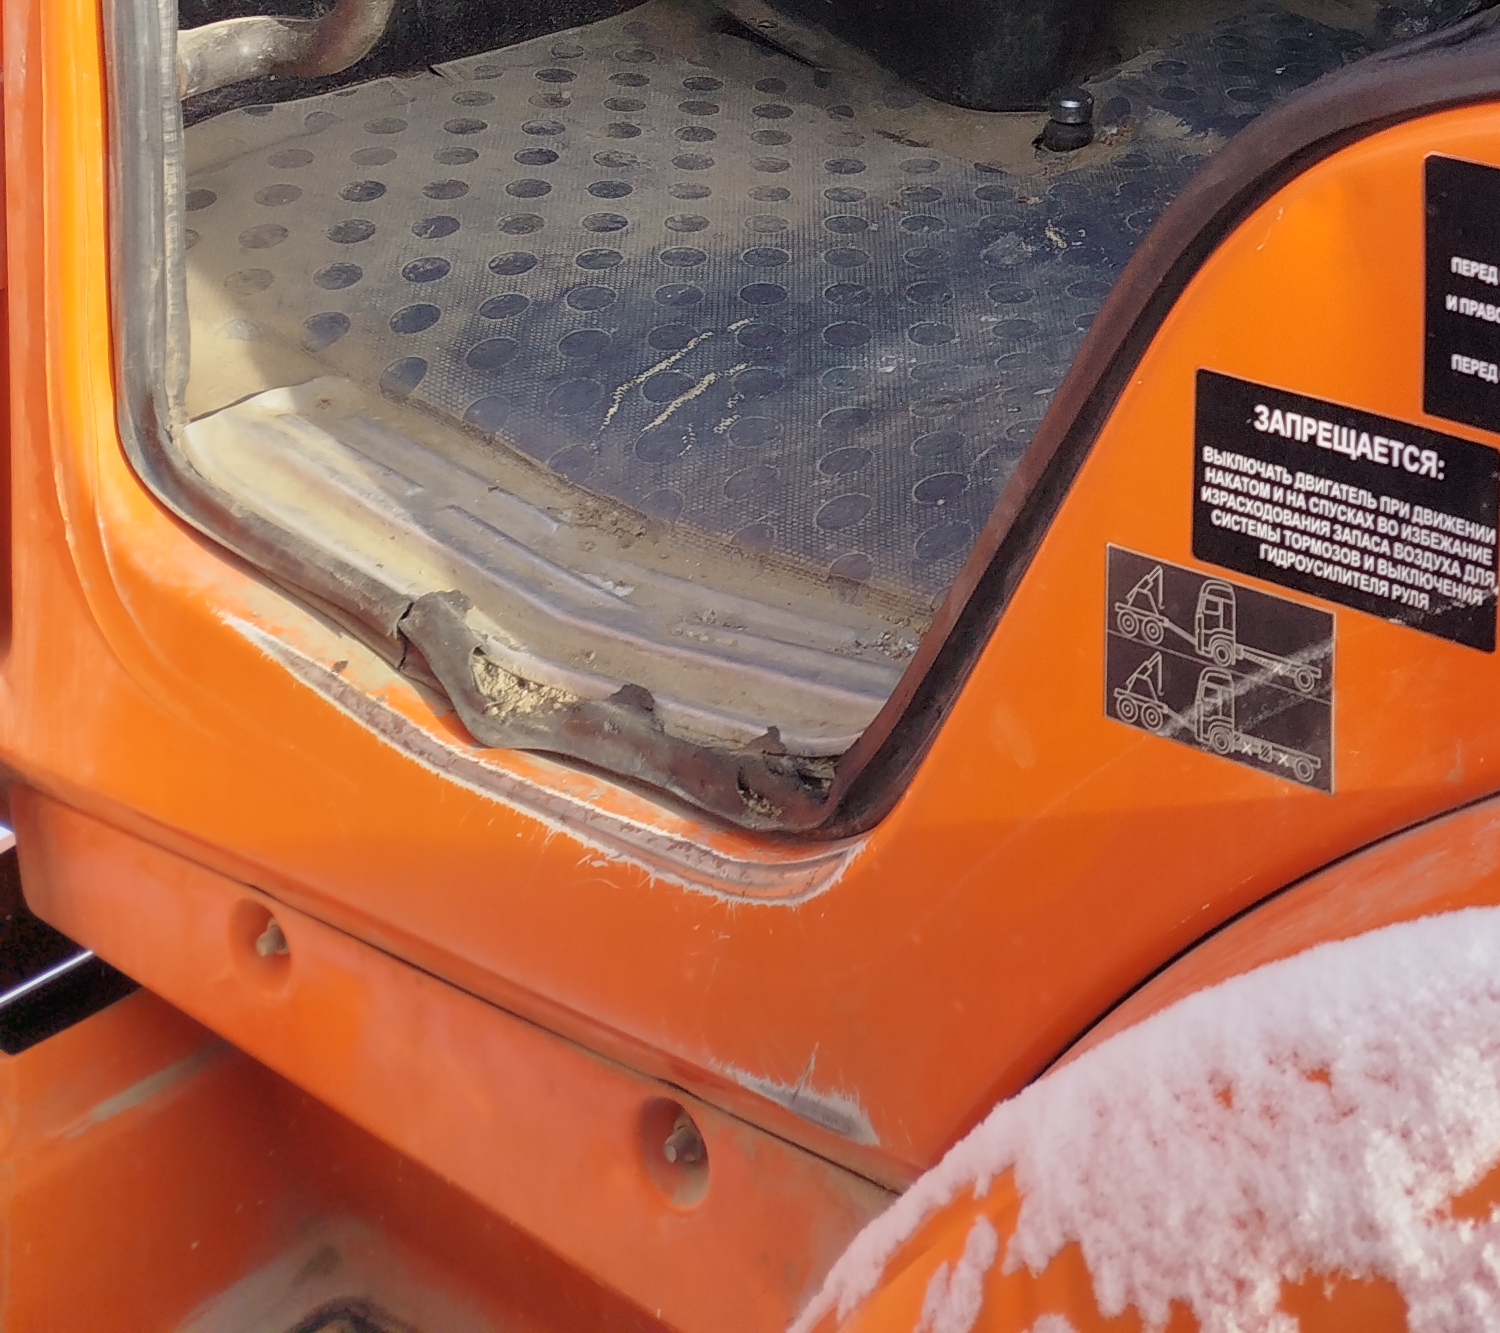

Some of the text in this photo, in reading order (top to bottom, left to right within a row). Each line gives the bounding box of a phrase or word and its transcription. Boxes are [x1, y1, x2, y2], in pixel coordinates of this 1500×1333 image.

[1445, 294, 1458, 312] И
[1451, 256, 1499, 286] ПЕРЕД
[1451, 353, 1499, 384] ПЕРЕД
[1253, 404, 1446, 481] ЗАПРЕЩАЕТСЯ:
[1202, 445, 1497, 546] ВЫКЛЮЧАТЬ ДВИГАТЕЛЬ ПРИ ДВИЖЕНИИ
[1204, 466, 1493, 566] НАКАТОМ И НА СПУСКАХ ВО ИЗБЕЖАНИЕ
[1200, 485, 1496, 588] ИЗРАСХОДОВАНИЯ ЗАПАСА ВОЗДУХА ДЛЯ
[1211, 509, 1484, 607] СИСТЕМЫ ТОРМОЗОВ И ВЫКЛЮЧЕНИЯ
[1259, 542, 1430, 611] ГИДРОУСИЛИТЕЛЯ РУЛЯ
